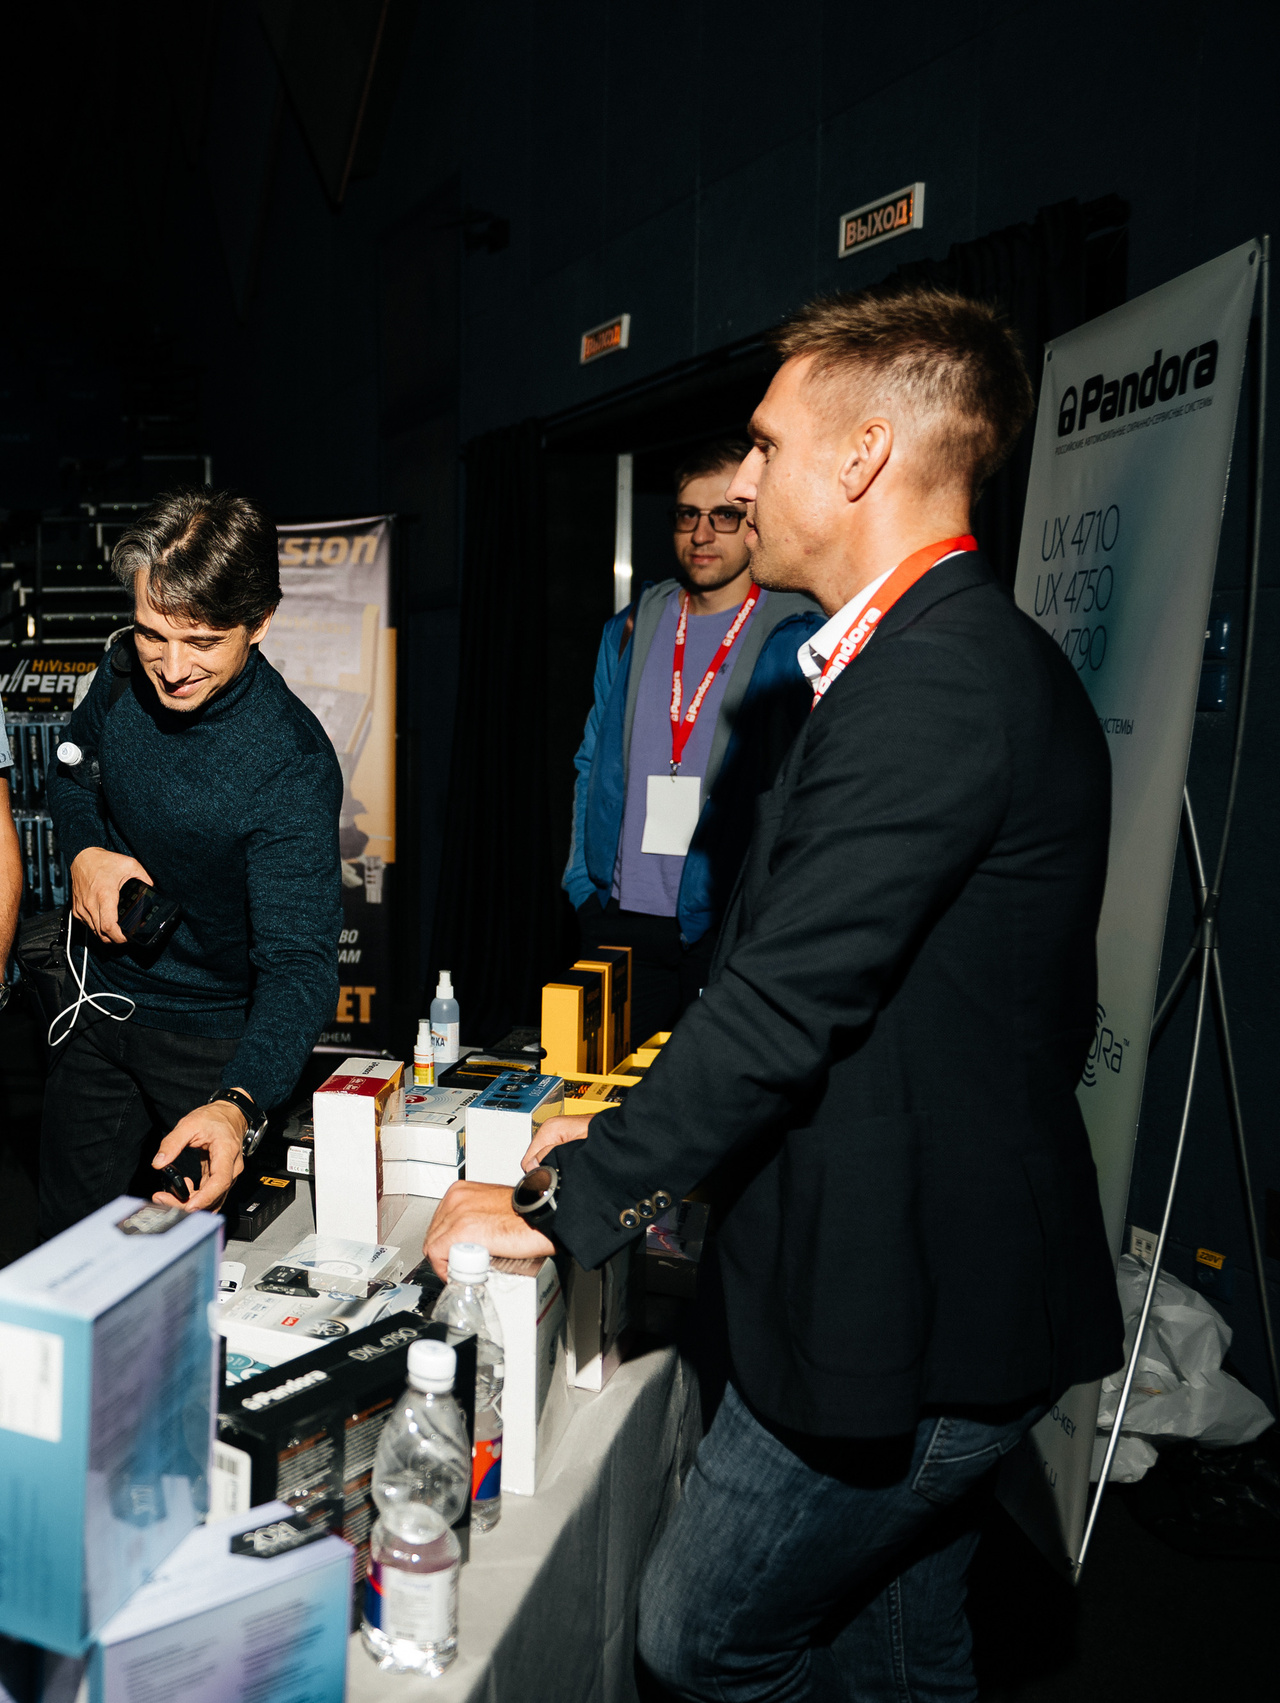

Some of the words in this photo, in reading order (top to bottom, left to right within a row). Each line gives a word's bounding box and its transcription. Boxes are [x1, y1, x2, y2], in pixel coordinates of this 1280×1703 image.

[846, 199, 908, 247] ВЫХОД
[1078, 339, 1219, 431] Pandora
[1041, 514, 1070, 562] UX
[1071, 504, 1120, 556] 4710
[1034, 571, 1063, 617] UX
[1064, 565, 1114, 614] 4750
[725, 597, 756, 640] Pandora
[671, 671, 681, 714] Pandora
[688, 671, 715, 716] Pandora
[1199, 1251, 1221, 1264] 220V
